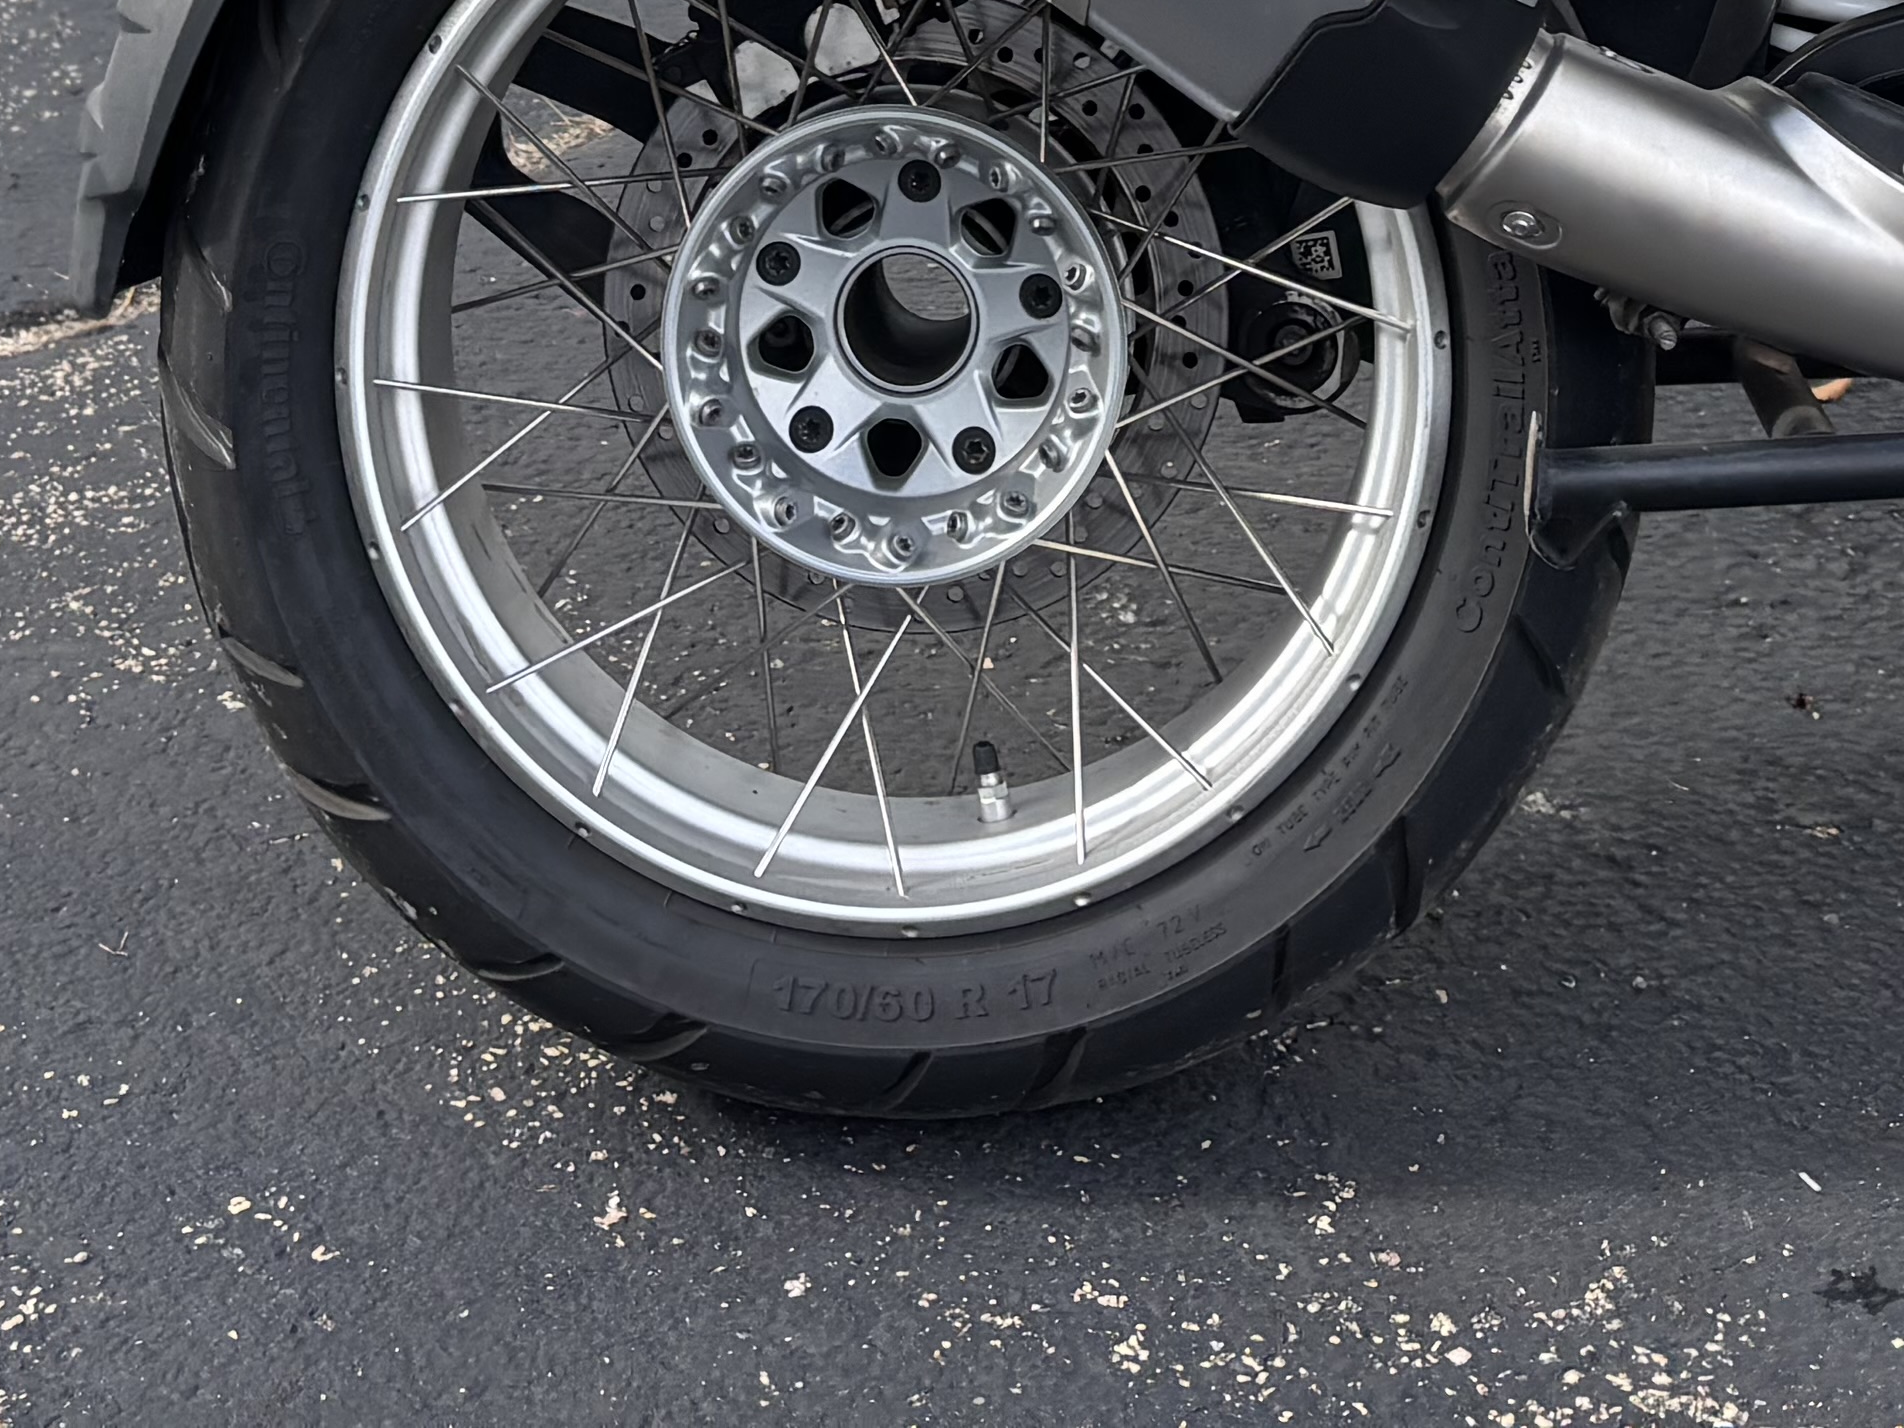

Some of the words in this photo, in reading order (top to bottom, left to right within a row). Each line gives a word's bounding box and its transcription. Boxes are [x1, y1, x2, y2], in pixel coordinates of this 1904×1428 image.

[1456, 248, 1528, 634] ContiTrailAtta
[772, 973, 936, 1024] 170/60
[952, 983, 991, 1020] R
[1006, 967, 1058, 1011] 17
[1156, 914, 1185, 939] 72
